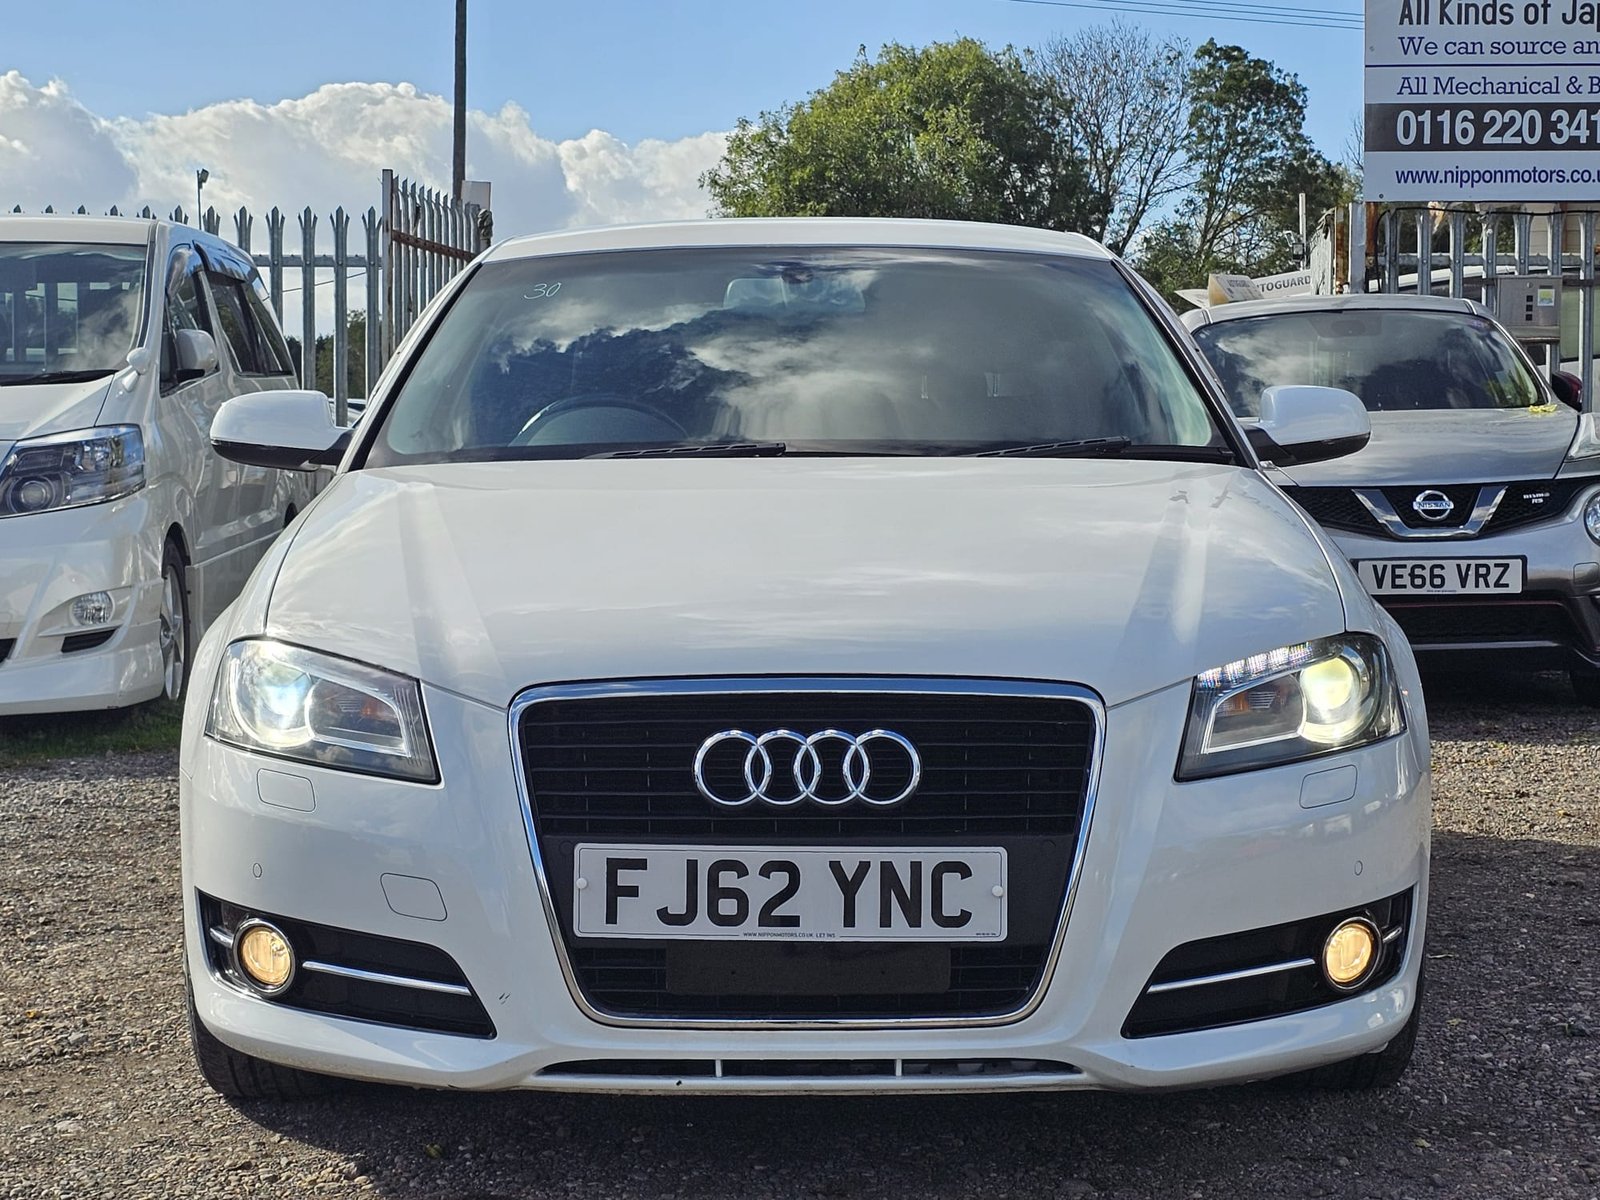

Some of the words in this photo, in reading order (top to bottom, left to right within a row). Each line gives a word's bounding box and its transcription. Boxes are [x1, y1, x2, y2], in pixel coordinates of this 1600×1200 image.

[1399, 0, 1430, 26] All
[1439, 0, 1515, 26] Kinds
[1523, 0, 1552, 26] of
[1397, 36, 1438, 56] We
[1444, 41, 1485, 55] can
[1490, 40, 1567, 55] source
[1396, 76, 1428, 96] All
[1433, 75, 1561, 95] Mechanical
[1566, 75, 1583, 95] &
[1396, 109, 1475, 145] 0116
[1482, 109, 1542, 145] 220
[523, 282, 562, 300] 30
[1257, 275, 1312, 293] TOGUARD
[1372, 563, 1446, 589] VE66
[1455, 563, 1510, 588] VRZ
[605, 857, 801, 928] FJ62
[828, 860, 973, 928] YNC
